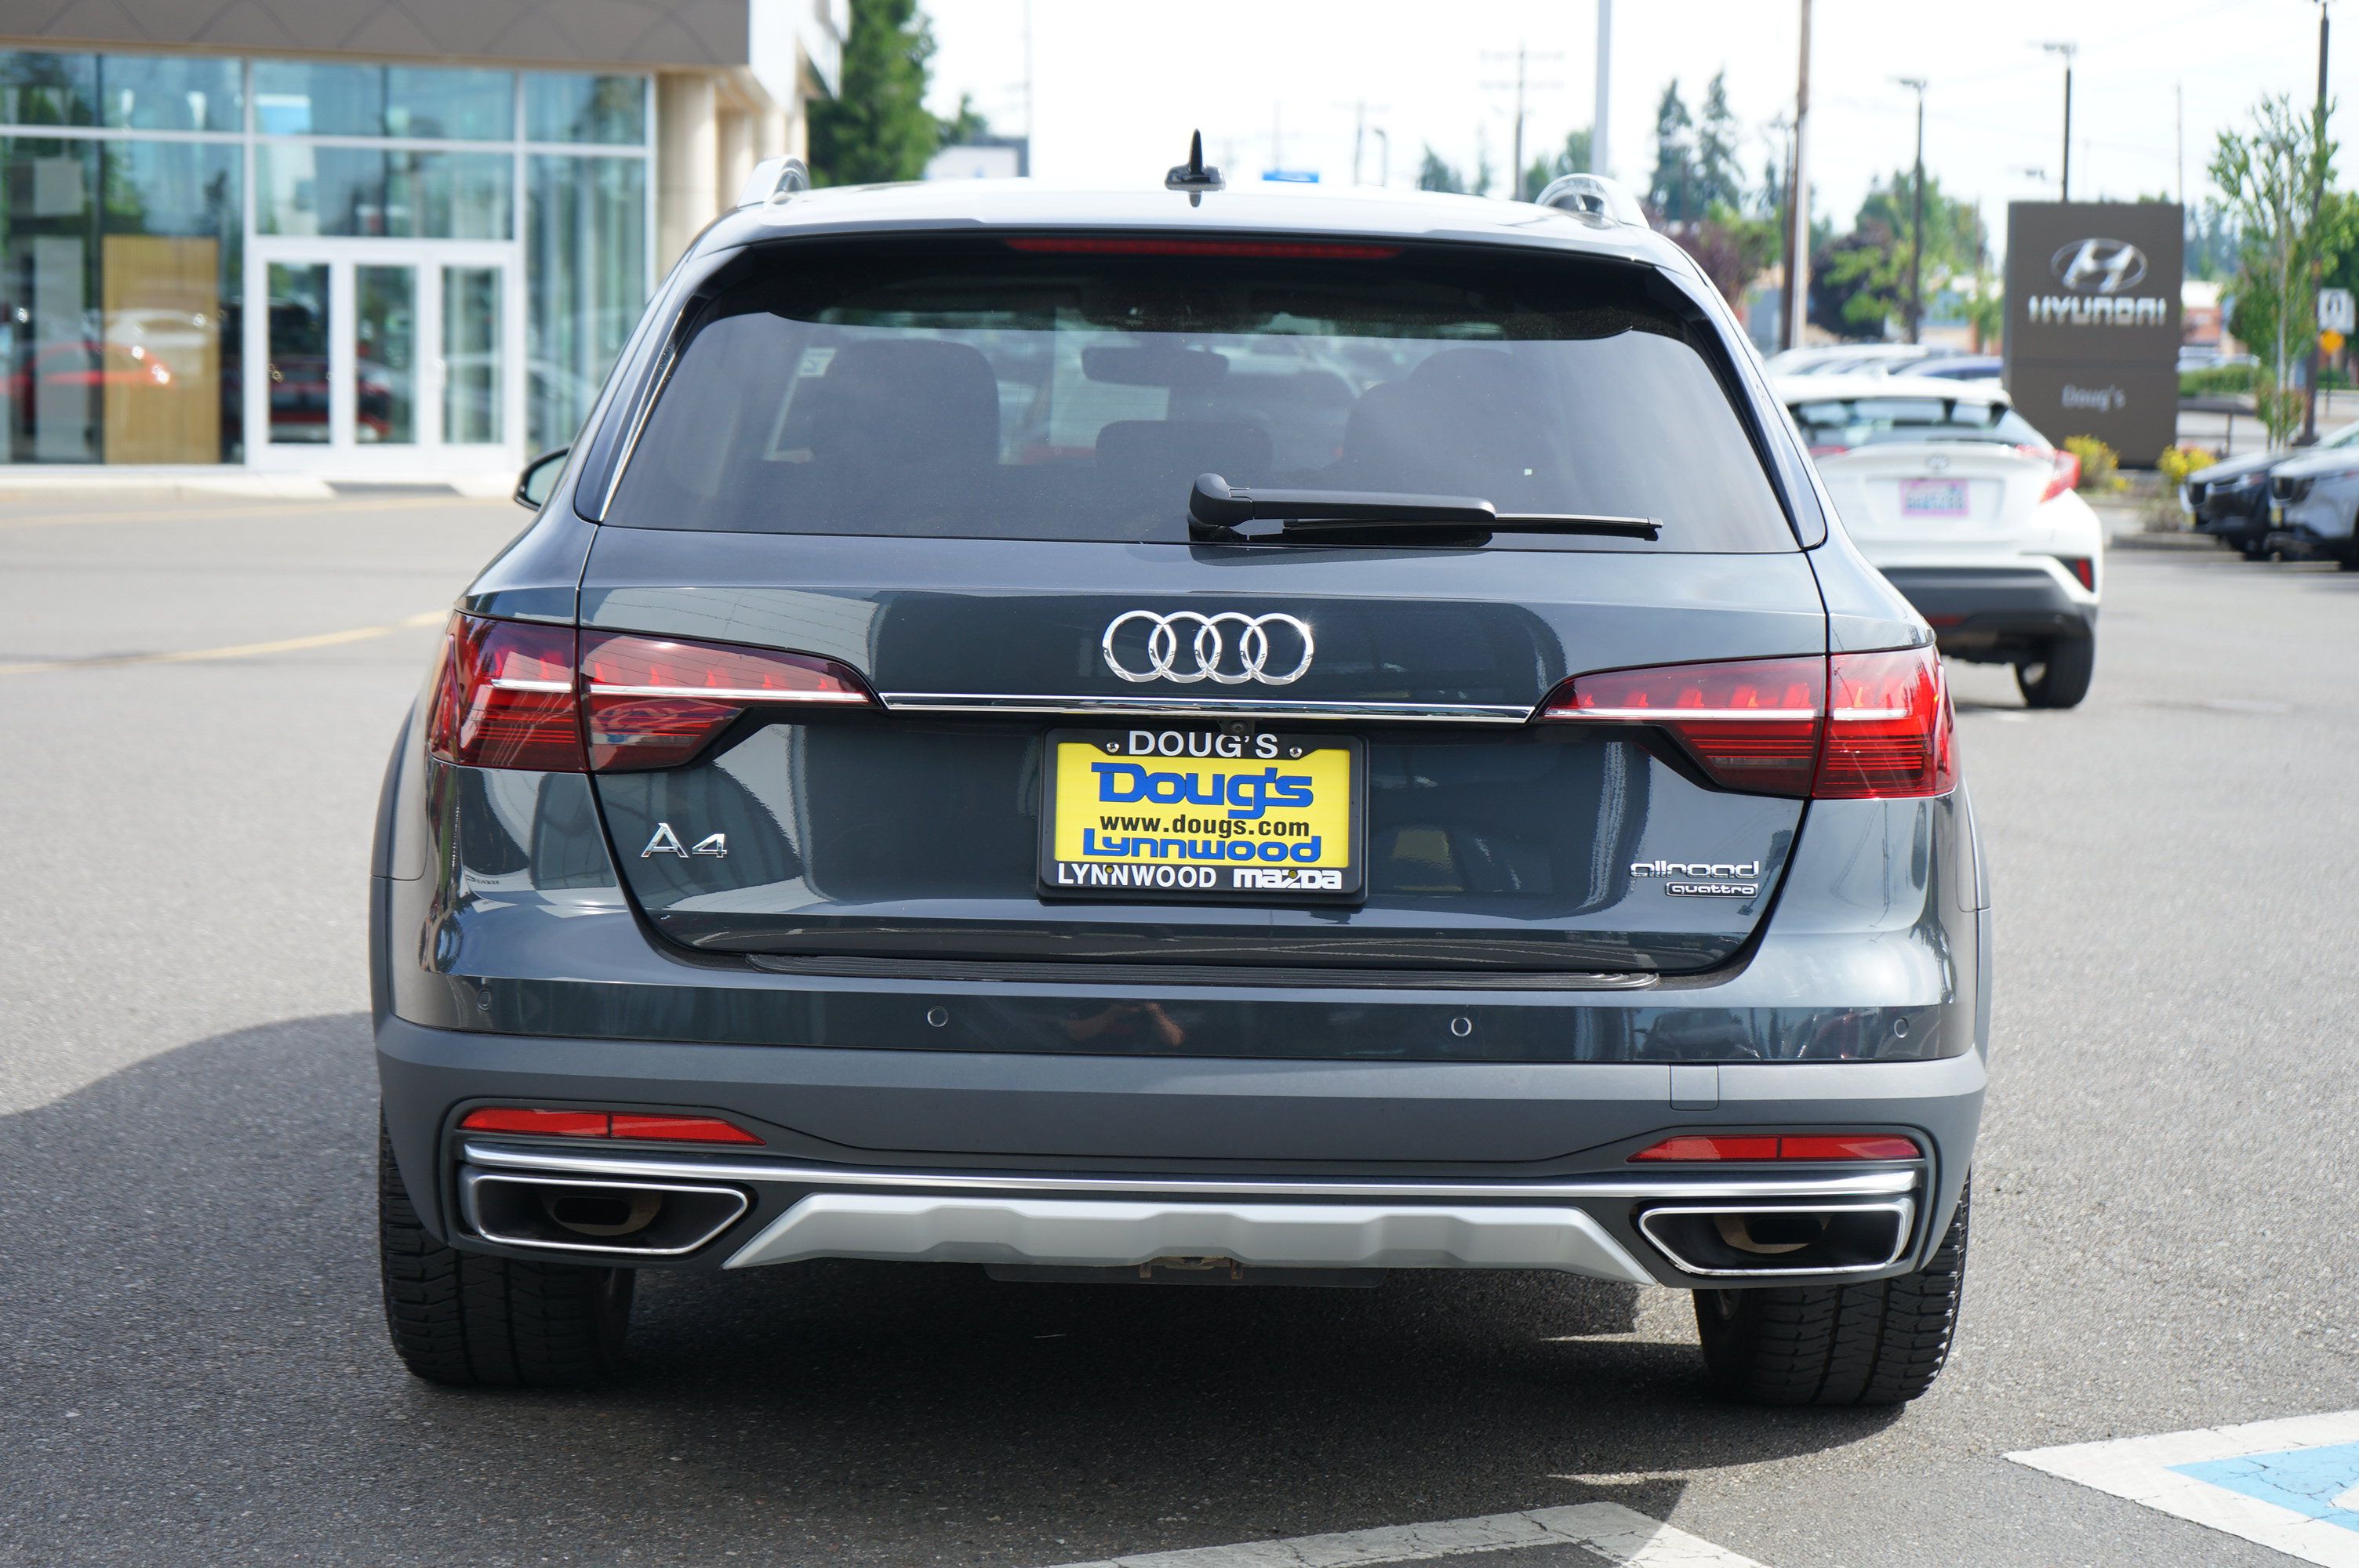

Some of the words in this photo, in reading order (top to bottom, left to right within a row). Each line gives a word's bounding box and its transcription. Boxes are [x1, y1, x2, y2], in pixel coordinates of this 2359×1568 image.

[2029, 296, 2167, 325] HYUNDAI
[2062, 383, 2125, 412] Doug's
[1129, 730, 1278, 759] DOUG'S
[1091, 761, 1314, 819] Doug's
[641, 822, 728, 858] A4
[1100, 814, 1310, 838] www.dougs.com
[1083, 828, 1321, 862] Lynnwood
[1058, 862, 1216, 888] LYNNWOOD
[1630, 860, 1759, 879] allroad
[1671, 884, 1755, 895] quattro
